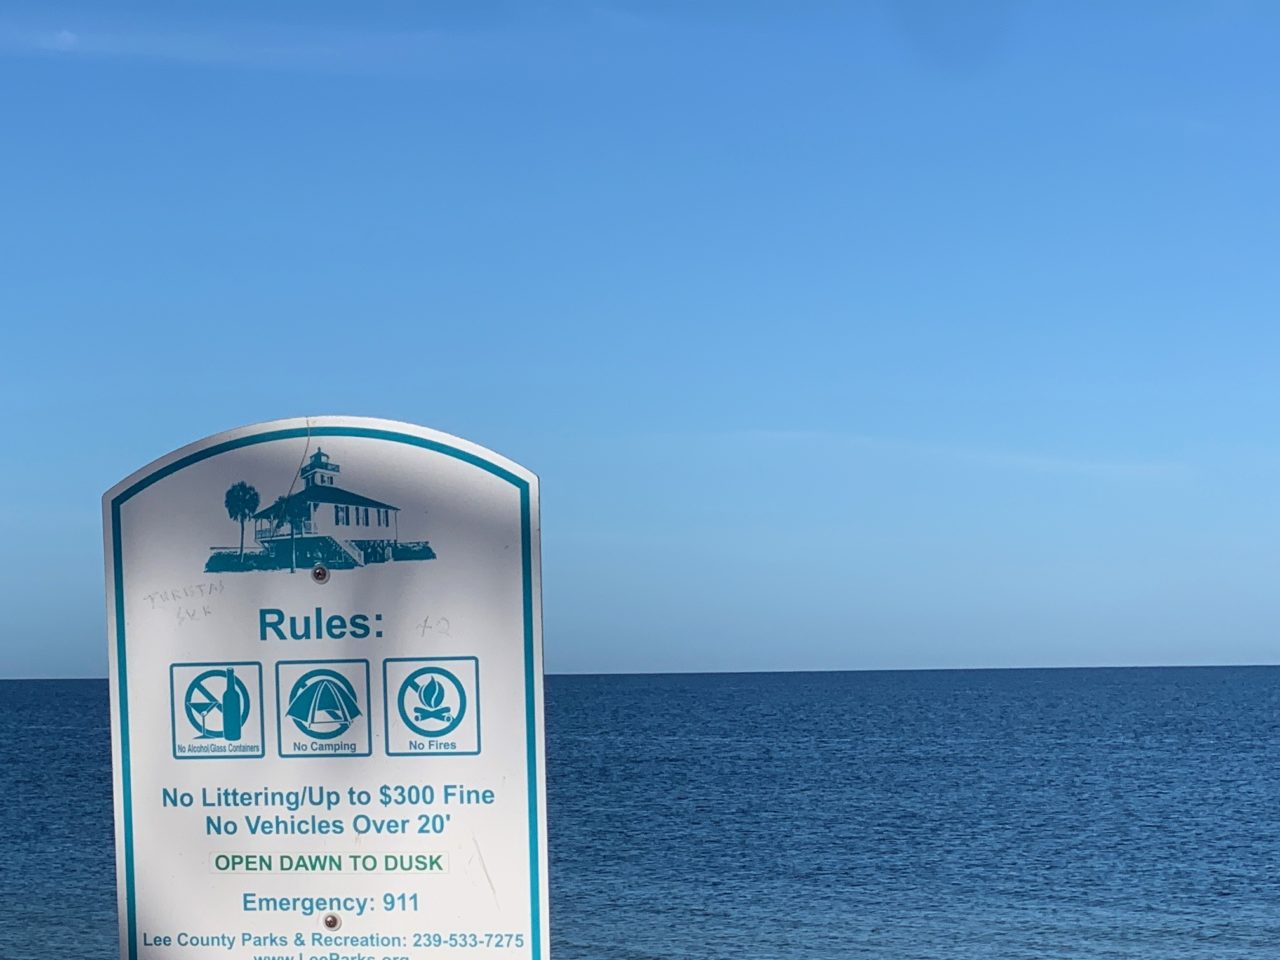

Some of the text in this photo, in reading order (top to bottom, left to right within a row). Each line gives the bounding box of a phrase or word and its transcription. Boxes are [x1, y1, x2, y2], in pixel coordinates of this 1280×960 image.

[259, 607, 384, 641] Rules:
[177, 743, 186, 753] No
[228, 743, 260, 753] Containers
[293, 741, 357, 754] No Camping
[409, 740, 457, 751] No Fires
[162, 784, 495, 811] No Littering/Up to $300 Fine
[205, 813, 451, 836] No Vehicles Over 20'
[214, 854, 443, 872] OPEN DAWN TO DUSK
[243, 892, 419, 916] Emergency: 911
[143, 932, 524, 950] Lee County Parks & Recreation: 239-533-7275
